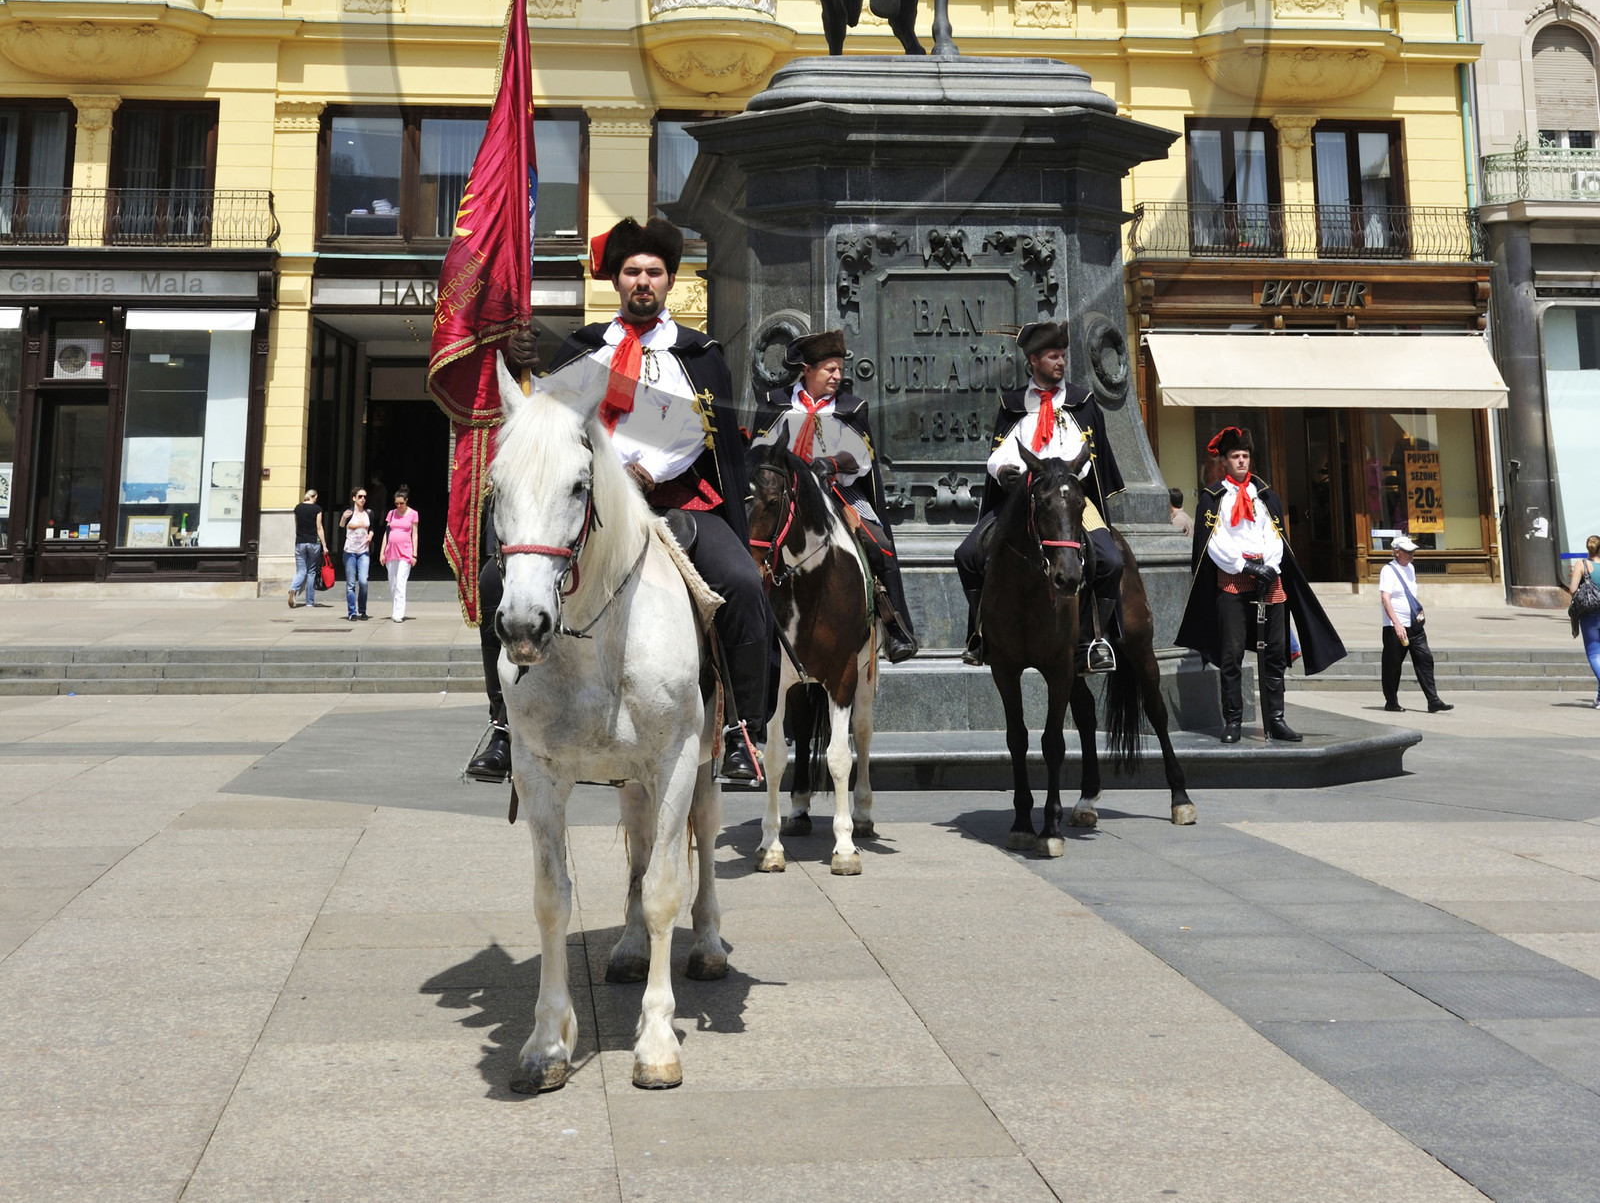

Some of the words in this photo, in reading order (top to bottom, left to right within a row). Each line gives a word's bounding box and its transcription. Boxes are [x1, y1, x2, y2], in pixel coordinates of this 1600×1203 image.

[8, 272, 116, 295] Galerija
[139, 272, 204, 294] Mala
[448, 278, 485, 316] AUREA
[1260, 280, 1368, 307] BASLER
[912, 298, 985, 337] BAN
[884, 344, 1016, 395] JELAČIĆ
[1407, 453, 1439, 464] POPUSTI
[1410, 472, 1437, 481] SEZONE
